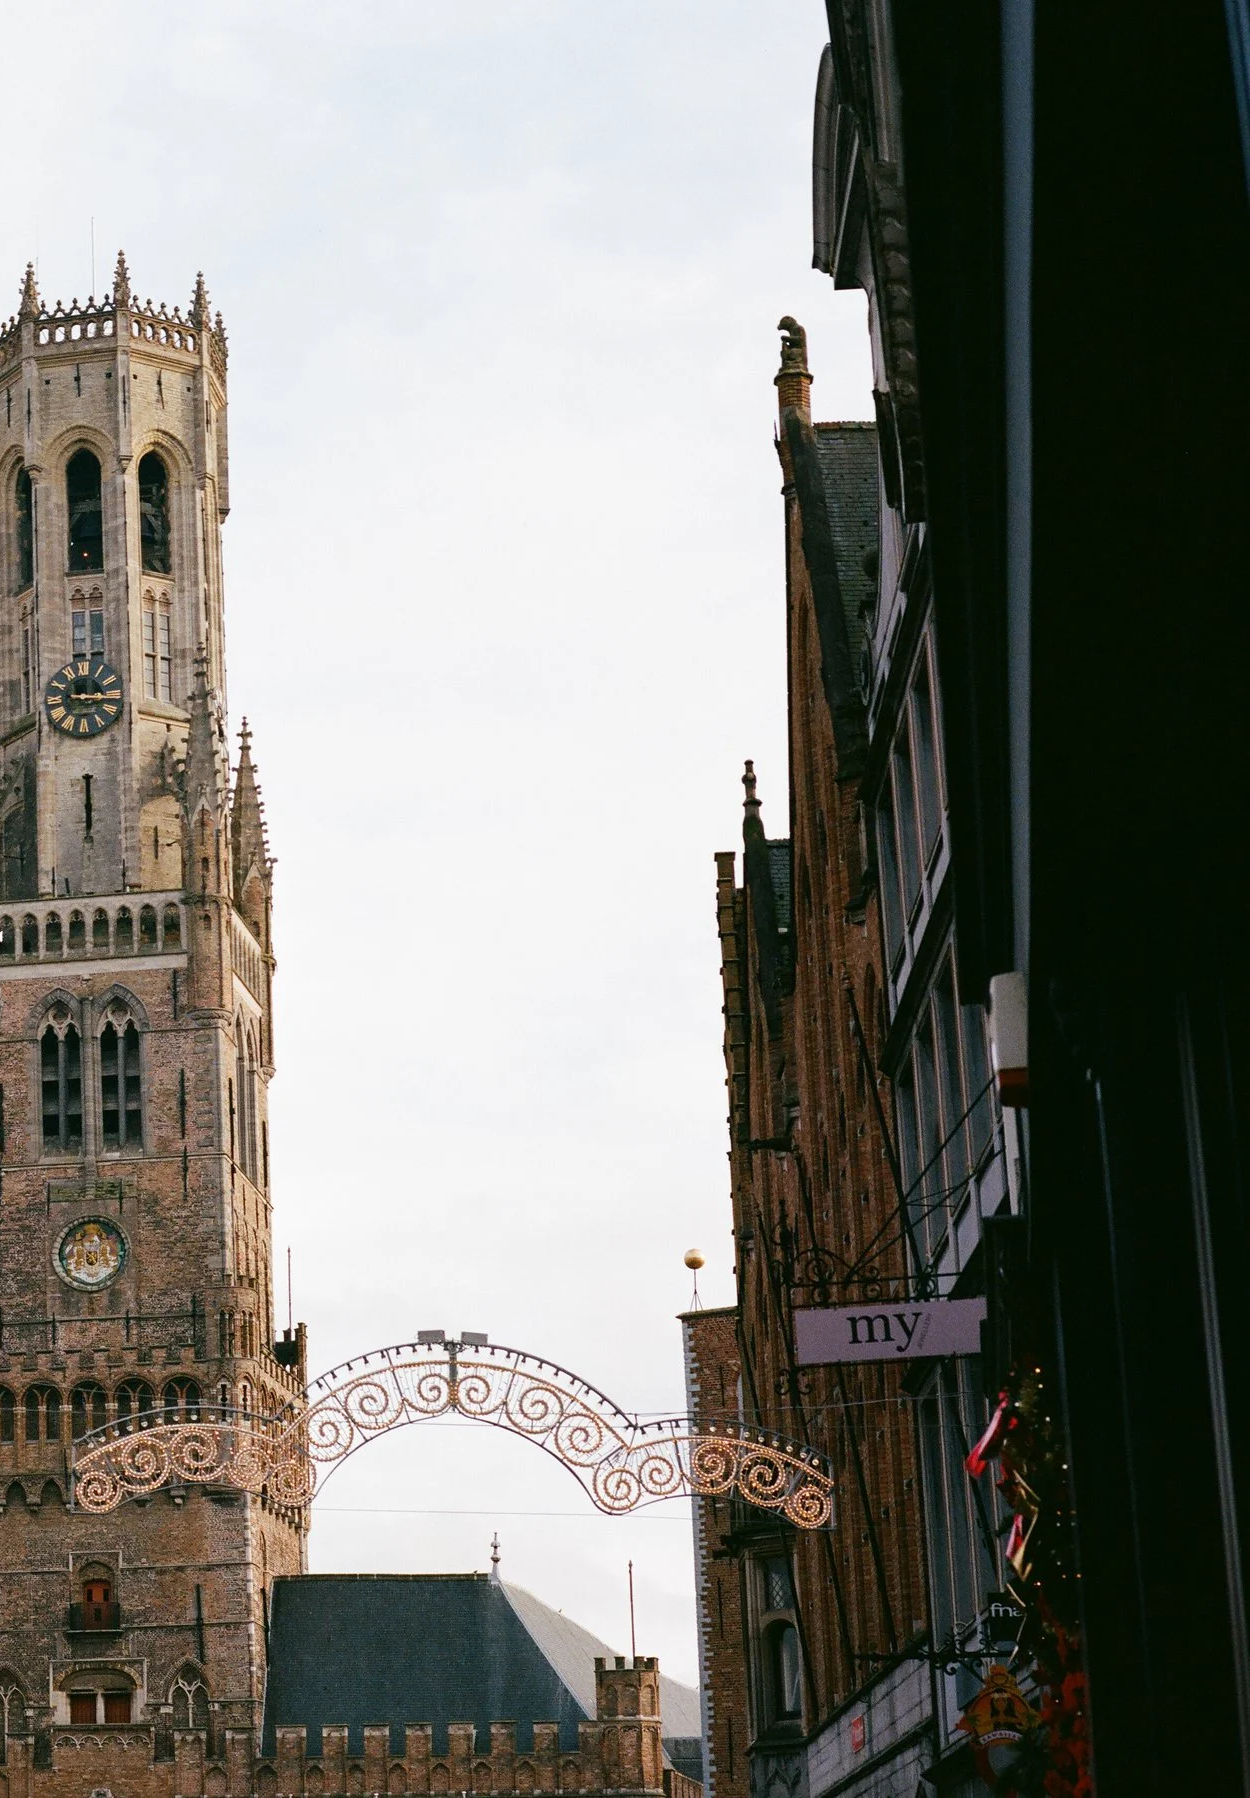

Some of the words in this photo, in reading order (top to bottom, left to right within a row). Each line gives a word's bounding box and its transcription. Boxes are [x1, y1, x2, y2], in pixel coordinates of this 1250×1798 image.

[77, 661, 89, 676] XII
[51, 680, 66, 690] X
[846, 1312, 923, 1353] my
[990, 1602, 1023, 1617] fna
